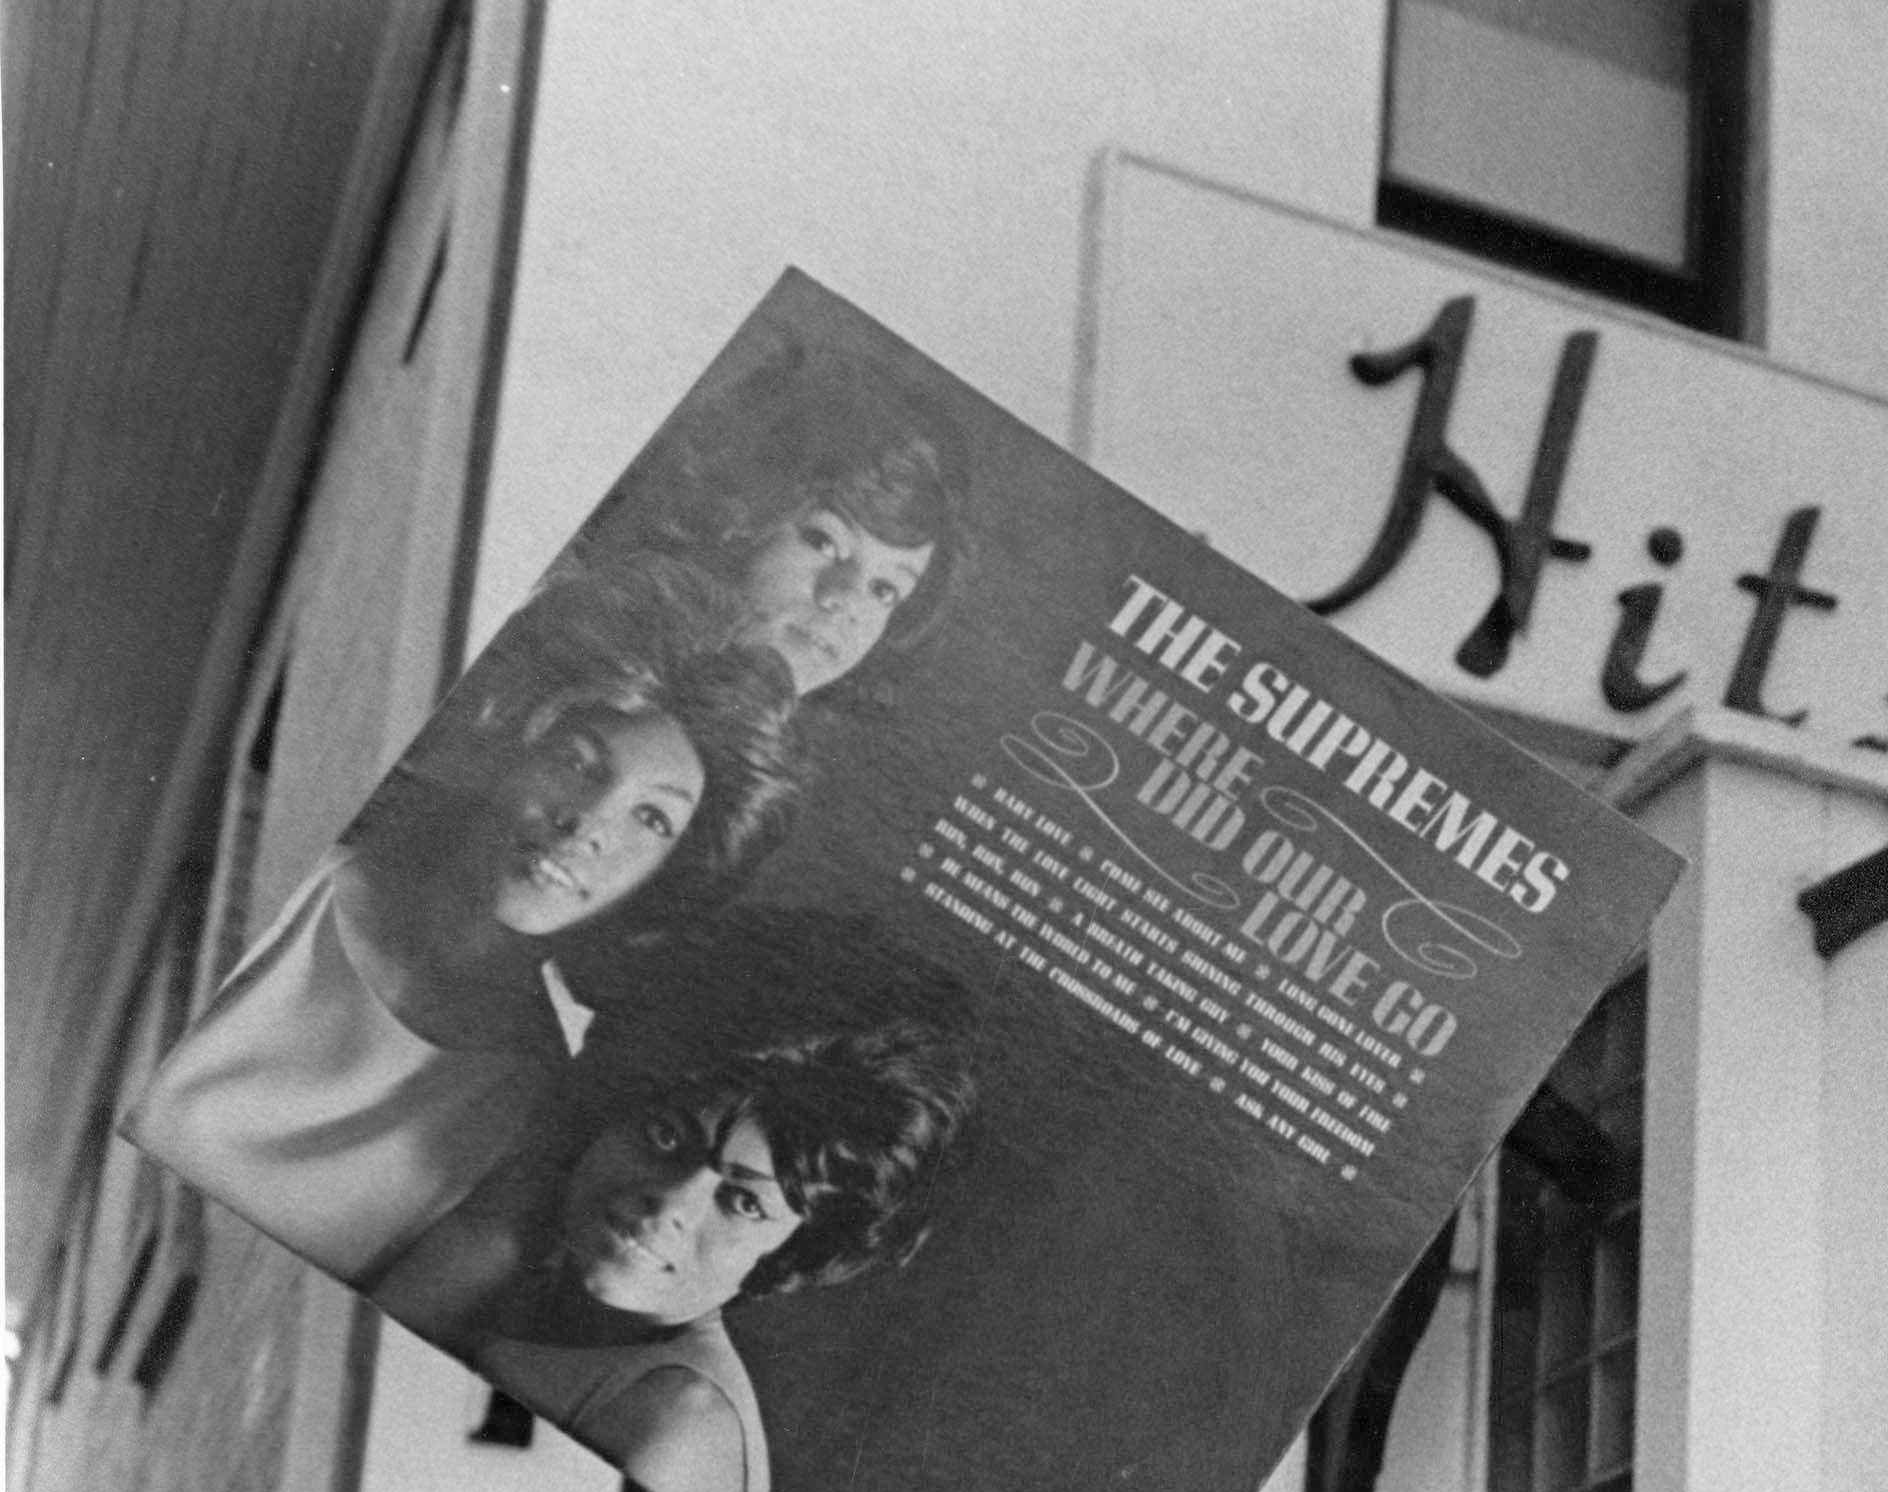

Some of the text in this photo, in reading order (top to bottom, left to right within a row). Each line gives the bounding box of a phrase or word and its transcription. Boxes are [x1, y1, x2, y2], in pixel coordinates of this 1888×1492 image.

[1061, 640, 1264, 802] WHERE
[1108, 574, 1570, 914] THE SUPREMES
[1135, 757, 1367, 938] DID OUR
[924, 882, 1331, 1164] STANDING AT THE CROSSROADS OF LOVE ASK ANY GIRL
[940, 857, 961, 877] HE
[963, 872, 1010, 910] MEANS
[1011, 904, 1037, 928] THE
[1039, 923, 1091, 964] WORLD
[1091, 959, 1113, 979] TO
[1113, 973, 1136, 995] ME
[1191, 1027, 1239, 1065] GIVING
[1240, 1058, 1271, 1086] YOU
[1271, 1080, 1310, 1113] YOUR
[1309, 1107, 1375, 1157] FREEDOM
[954, 795, 1386, 1093] WHEN THE LOVE LIGHT STARTS SHINING THROUGH HIS EYES
[993, 787, 1402, 1068] BABY LOVE COME SEE ABOUT ME LONG GONE LOVER
[1009, 869, 1041, 897] RUN
[1071, 912, 1084, 927] A
[1086, 922, 1144, 966] BREATH
[1146, 962, 1198, 1002] TAKING
[1199, 997, 1229, 1024] GUY
[1261, 1038, 1299, 1071] YOUR
[1301, 1066, 1336, 1095] KISS
[1337, 1090, 1357, 1109] OF
[1358, 1105, 1391, 1133] FIRE
[1239, 890, 1458, 1057] LOVE GO
